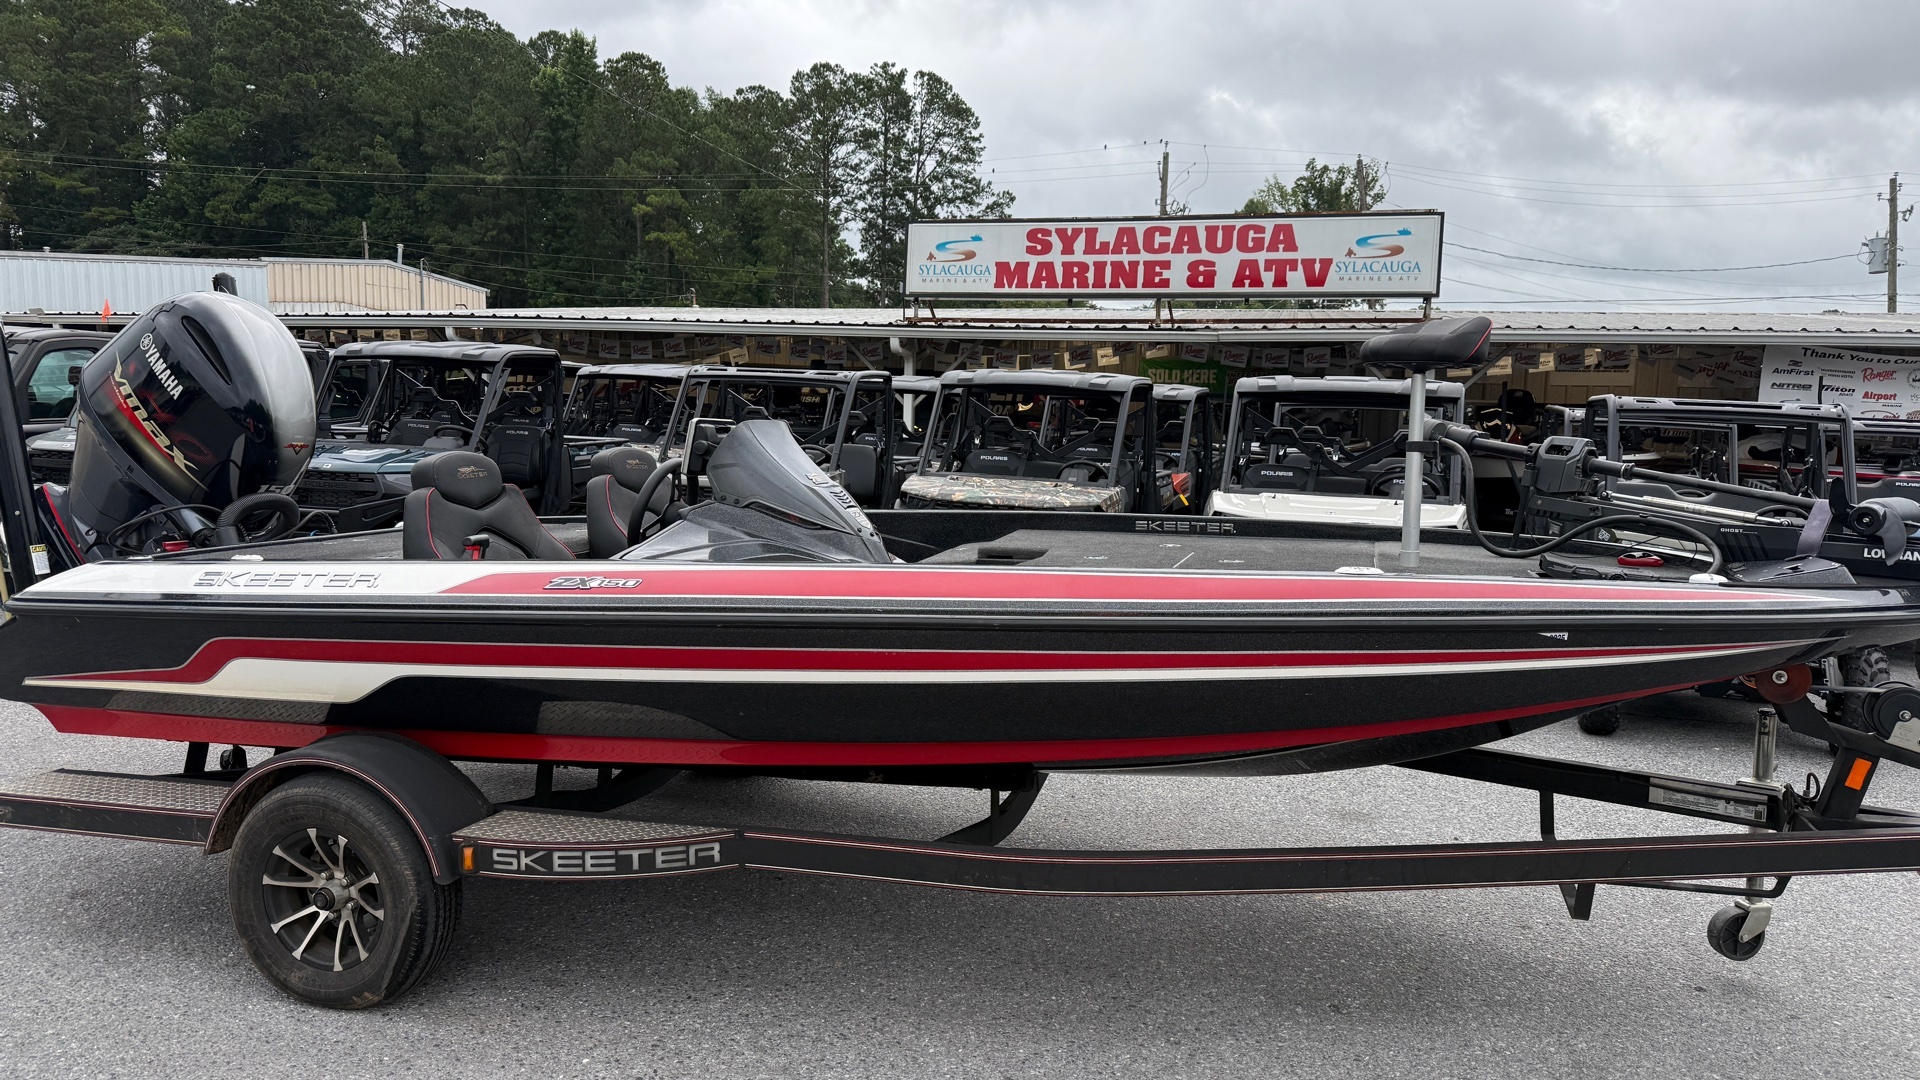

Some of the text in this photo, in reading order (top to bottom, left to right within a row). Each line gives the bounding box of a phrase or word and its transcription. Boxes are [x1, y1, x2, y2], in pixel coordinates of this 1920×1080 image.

[1025, 223, 1299, 256] SYLACAUGA
[918, 264, 992, 277] SYLACAUGA
[1334, 260, 1422, 273] SYLACAUGA
[994, 258, 1334, 289] MARINE & ATV
[1224, 350, 1245, 362] Ranger
[1265, 353, 1286, 364] Ranger
[1306, 353, 1327, 364] Ranger
[1514, 352, 1537, 364] Ranger
[1558, 353, 1581, 365] Ranger
[1733, 351, 1757, 365] Ranger
[1801, 347, 1846, 361] Thank
[1849, 354, 1875, 363] You
[1877, 357, 1891, 365] to
[145, 344, 184, 401] YAMAHA
[1148, 369, 1217, 384] SOLD HERE
[1771, 367, 1815, 376] AmFirst
[1861, 367, 1897, 383] Ranger
[1770, 382, 1813, 390] NITRO
[1821, 384, 1856, 393] Triton
[1861, 391, 1897, 402] Airport
[258, 484, 296, 495] 150
[1135, 520, 1235, 534] SKEETER
[193, 571, 381, 589] SKEETER
[492, 842, 721, 873] SKEETER
